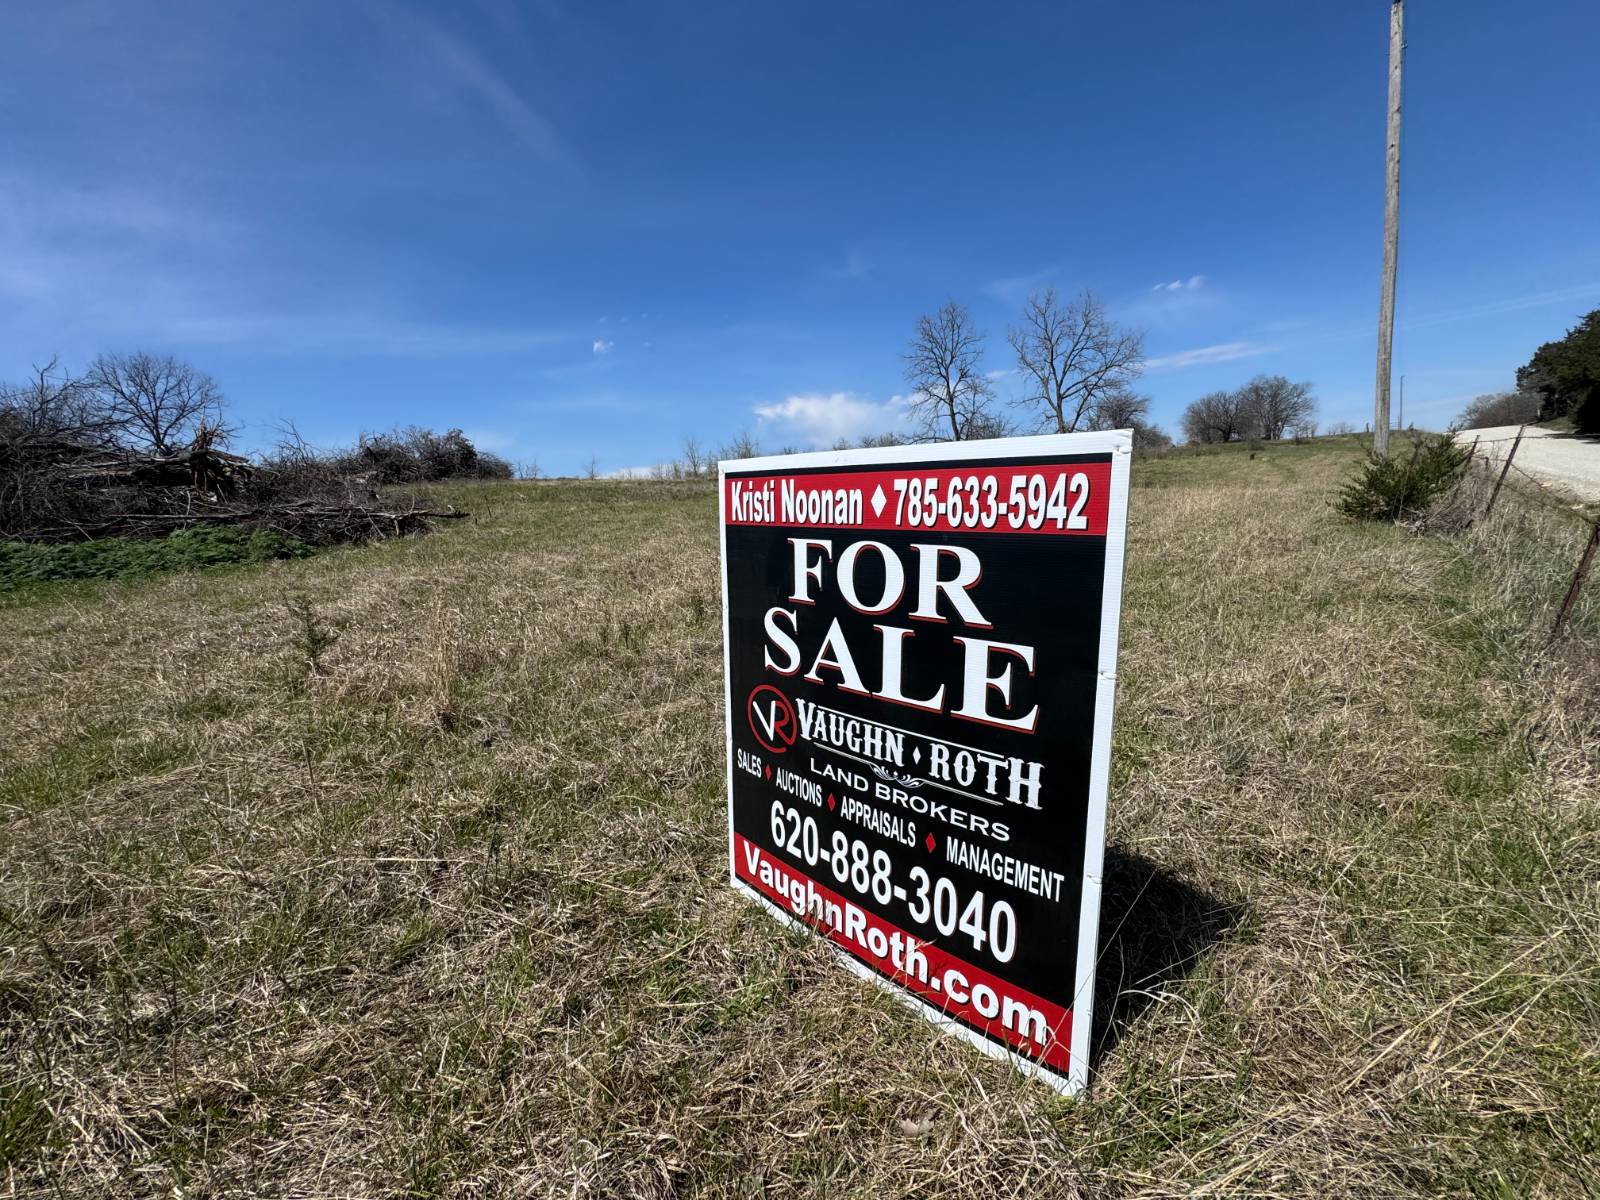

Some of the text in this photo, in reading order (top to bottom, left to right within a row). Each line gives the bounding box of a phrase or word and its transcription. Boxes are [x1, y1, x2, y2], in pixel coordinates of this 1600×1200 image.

[731, 472, 1090, 531] Kristi Noonan 785-633-5942
[787, 537, 994, 629] FOR
[764, 606, 1039, 734] SALE
[795, 698, 1045, 810] VAUGHN ROTH
[811, 758, 1010, 842] LAND BROKERS
[737, 748, 1065, 902] SALES AUCTIONS APPRAISALS MANAGEMENT
[771, 800, 1018, 963] 620-888-3040
[743, 840, 1047, 1046] VaughnRoth.com
